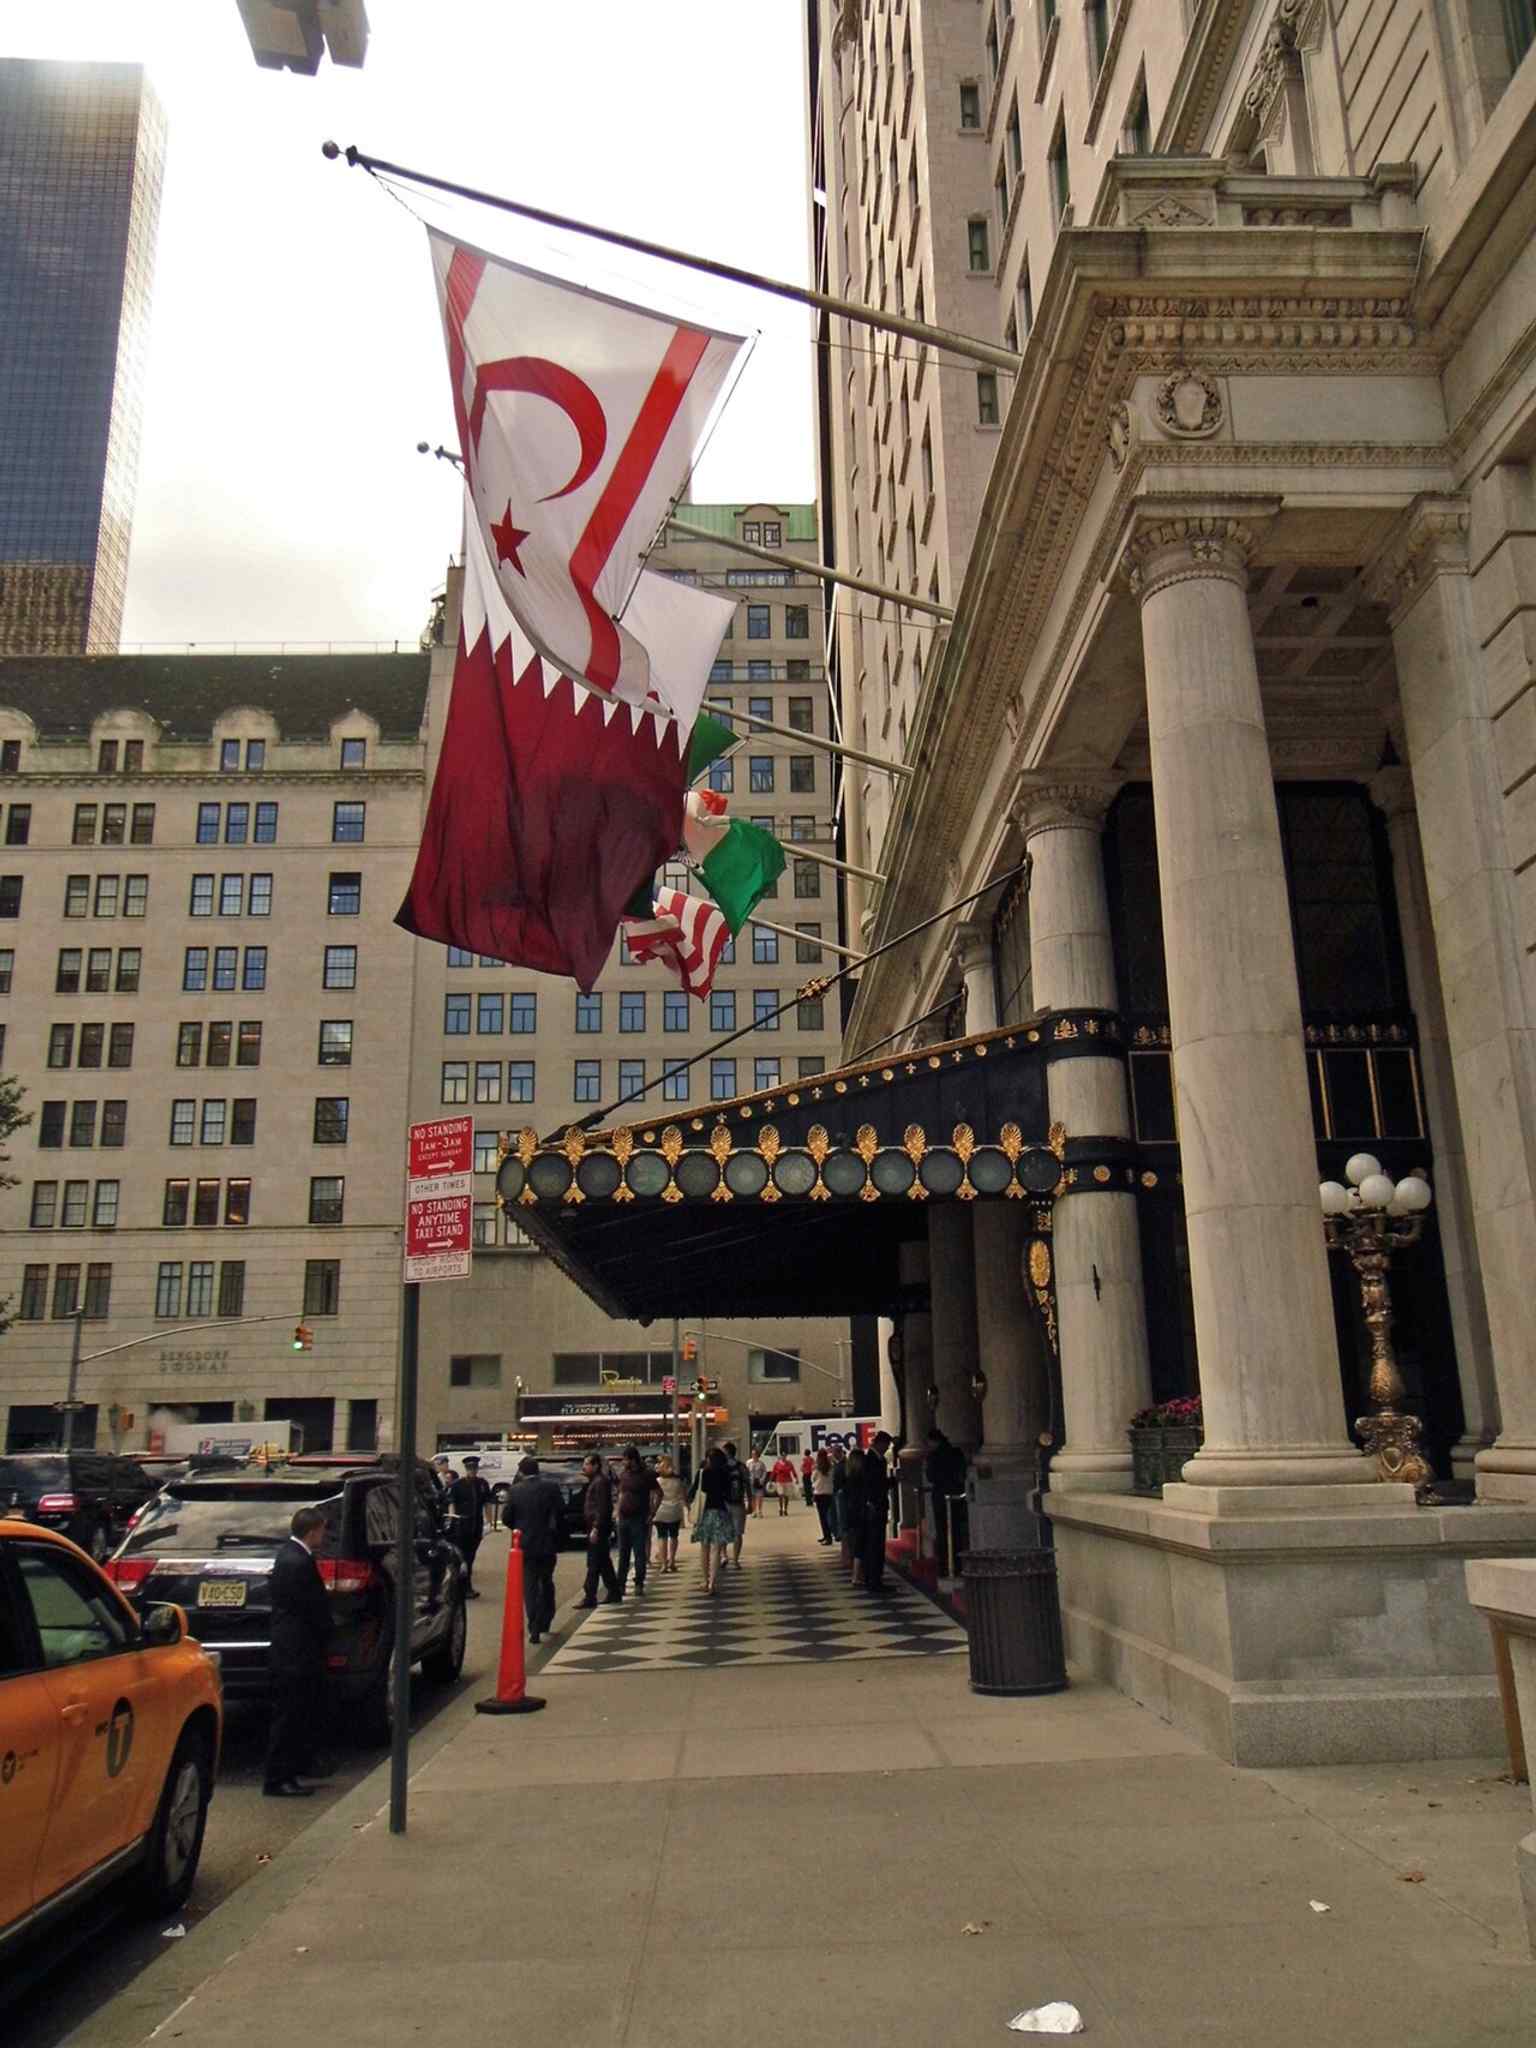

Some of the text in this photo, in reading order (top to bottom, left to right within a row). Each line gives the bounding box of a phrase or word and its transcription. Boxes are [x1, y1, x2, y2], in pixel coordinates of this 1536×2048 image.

[414, 1121, 469, 1140] NO STANDING
[415, 1179, 465, 1194] OTHER TIMES
[411, 1198, 467, 1216] NO STANDING
[418, 1212, 461, 1227] ANYTIME
[416, 1223, 463, 1240] TAXI STAND
[811, 1423, 876, 1452] FedE
